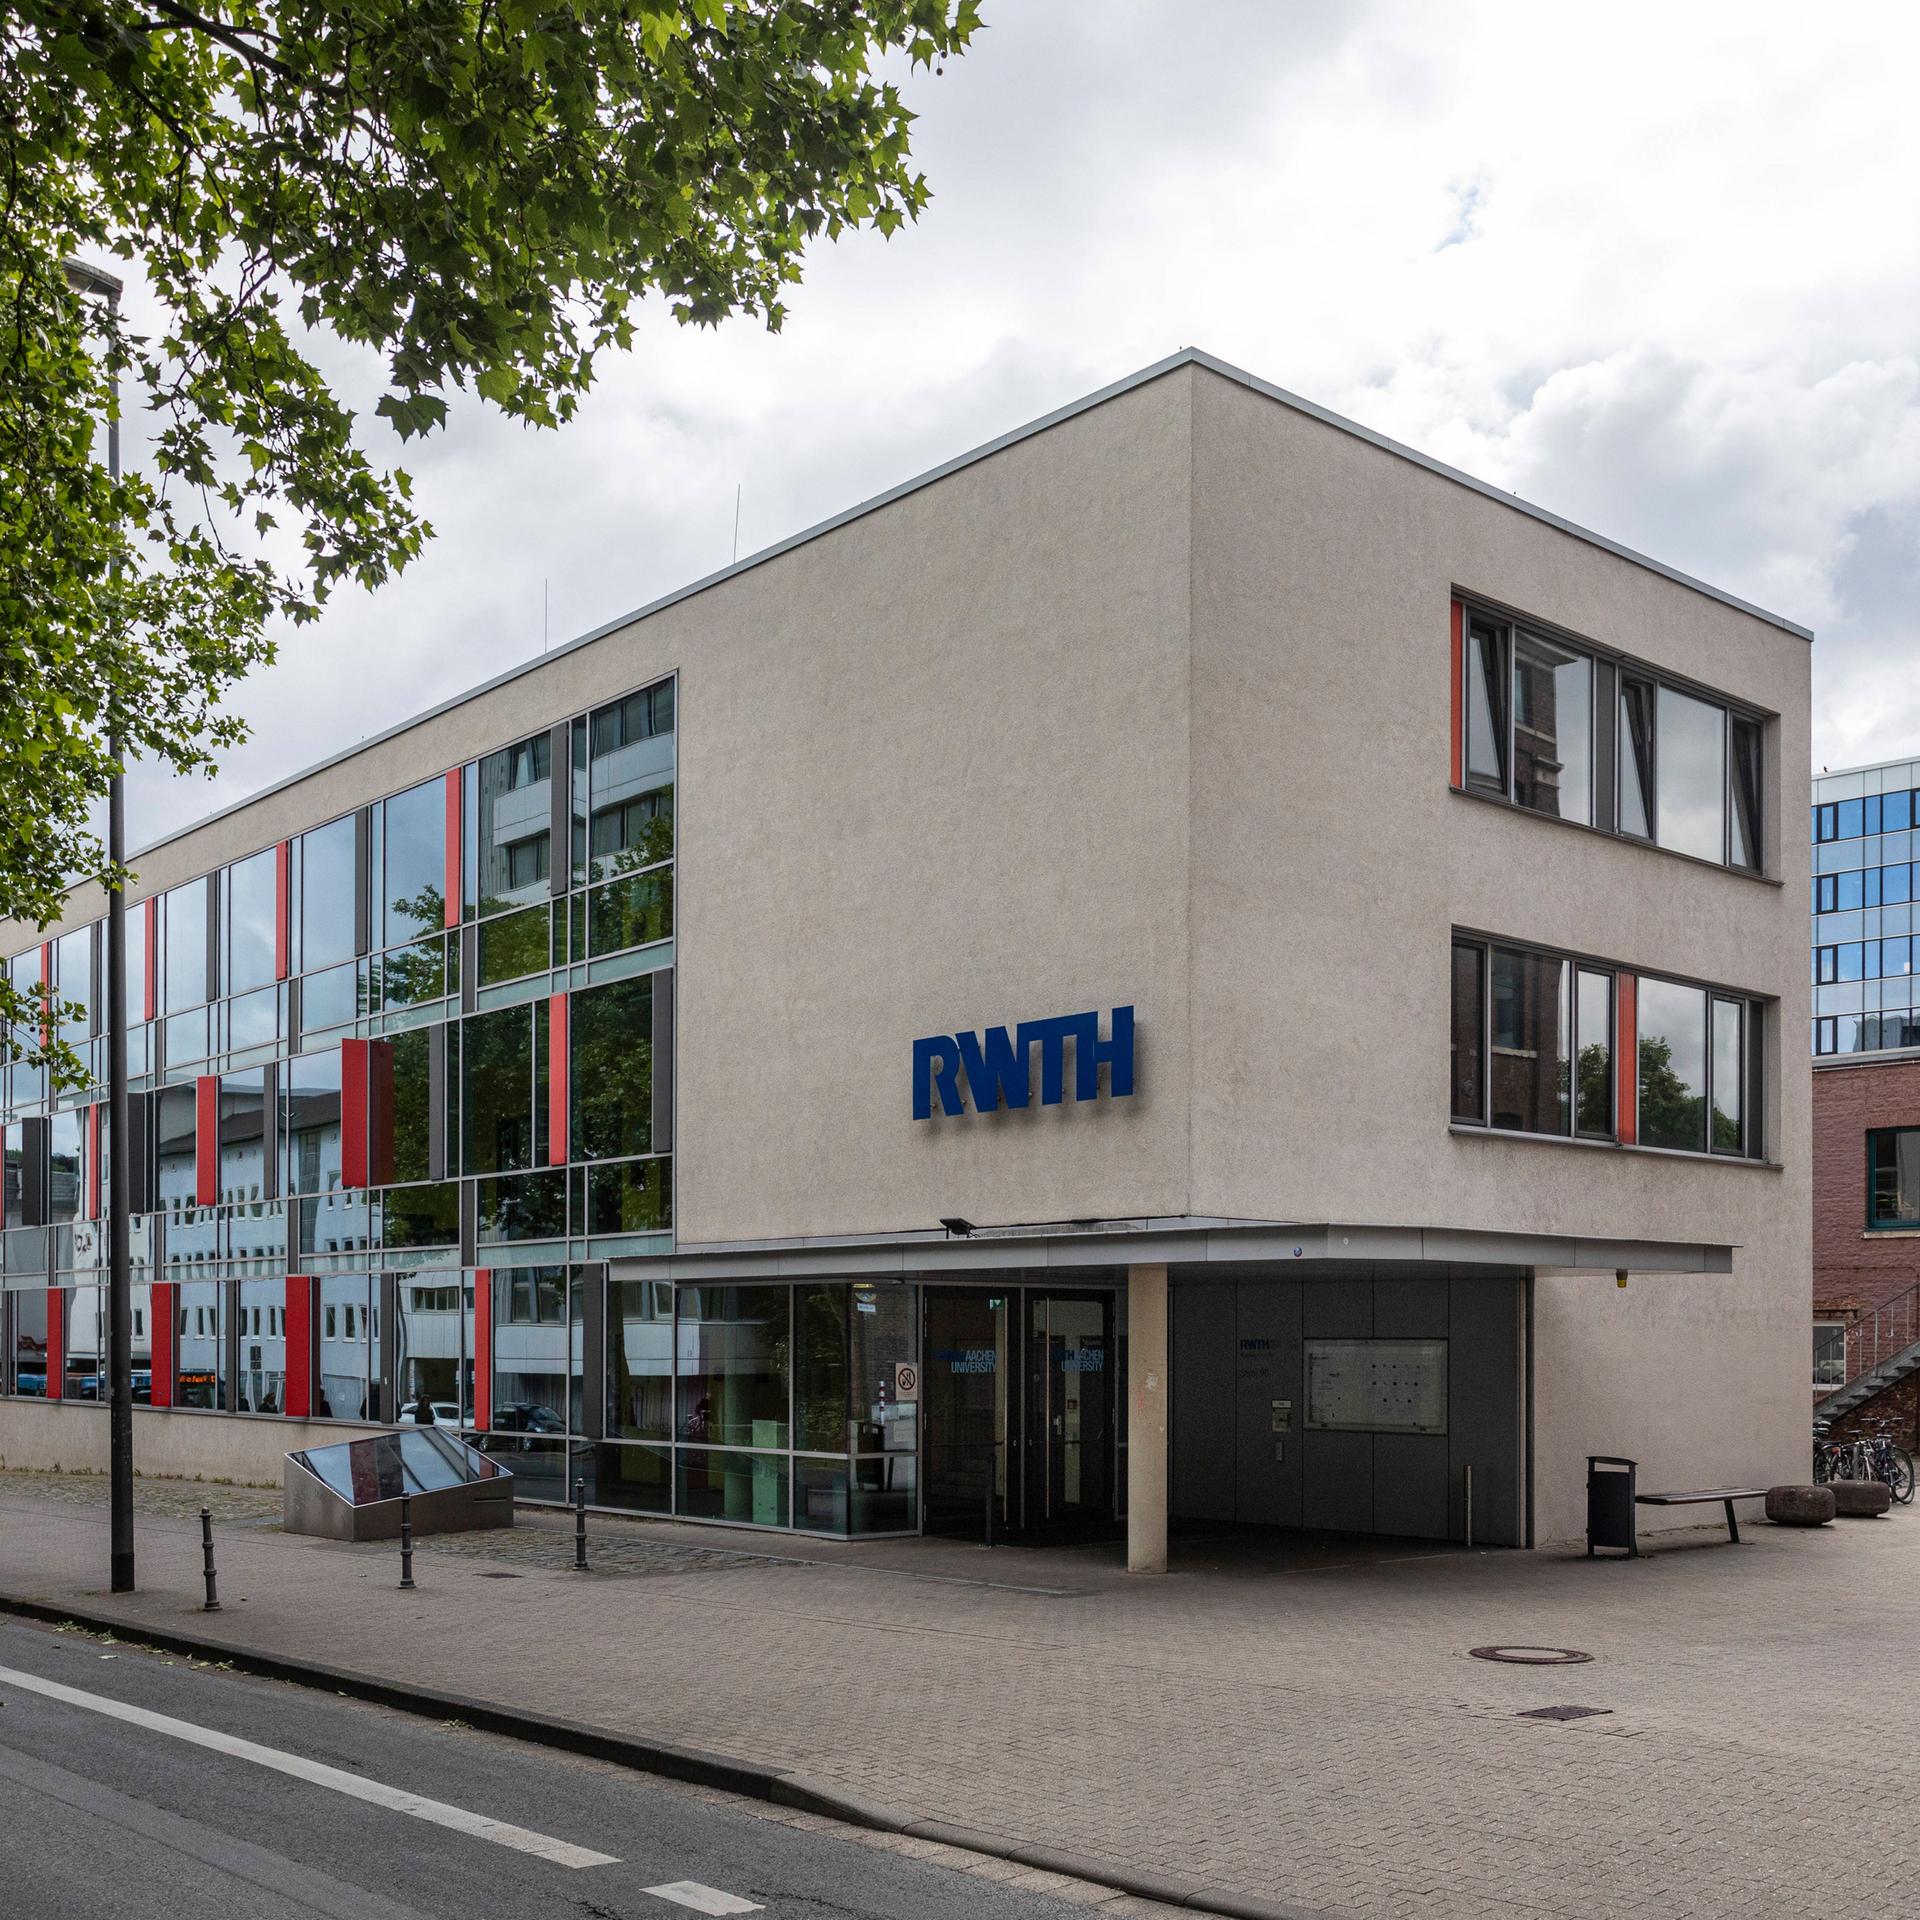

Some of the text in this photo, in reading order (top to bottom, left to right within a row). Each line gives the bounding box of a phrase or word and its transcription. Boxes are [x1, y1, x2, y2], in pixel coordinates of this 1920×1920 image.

[913, 1005, 1134, 1120] RWTH
[965, 1349, 998, 1361] AACHEN
[1075, 1349, 1104, 1361] ACHEN
[951, 1361, 997, 1374] UNIVERSITY
